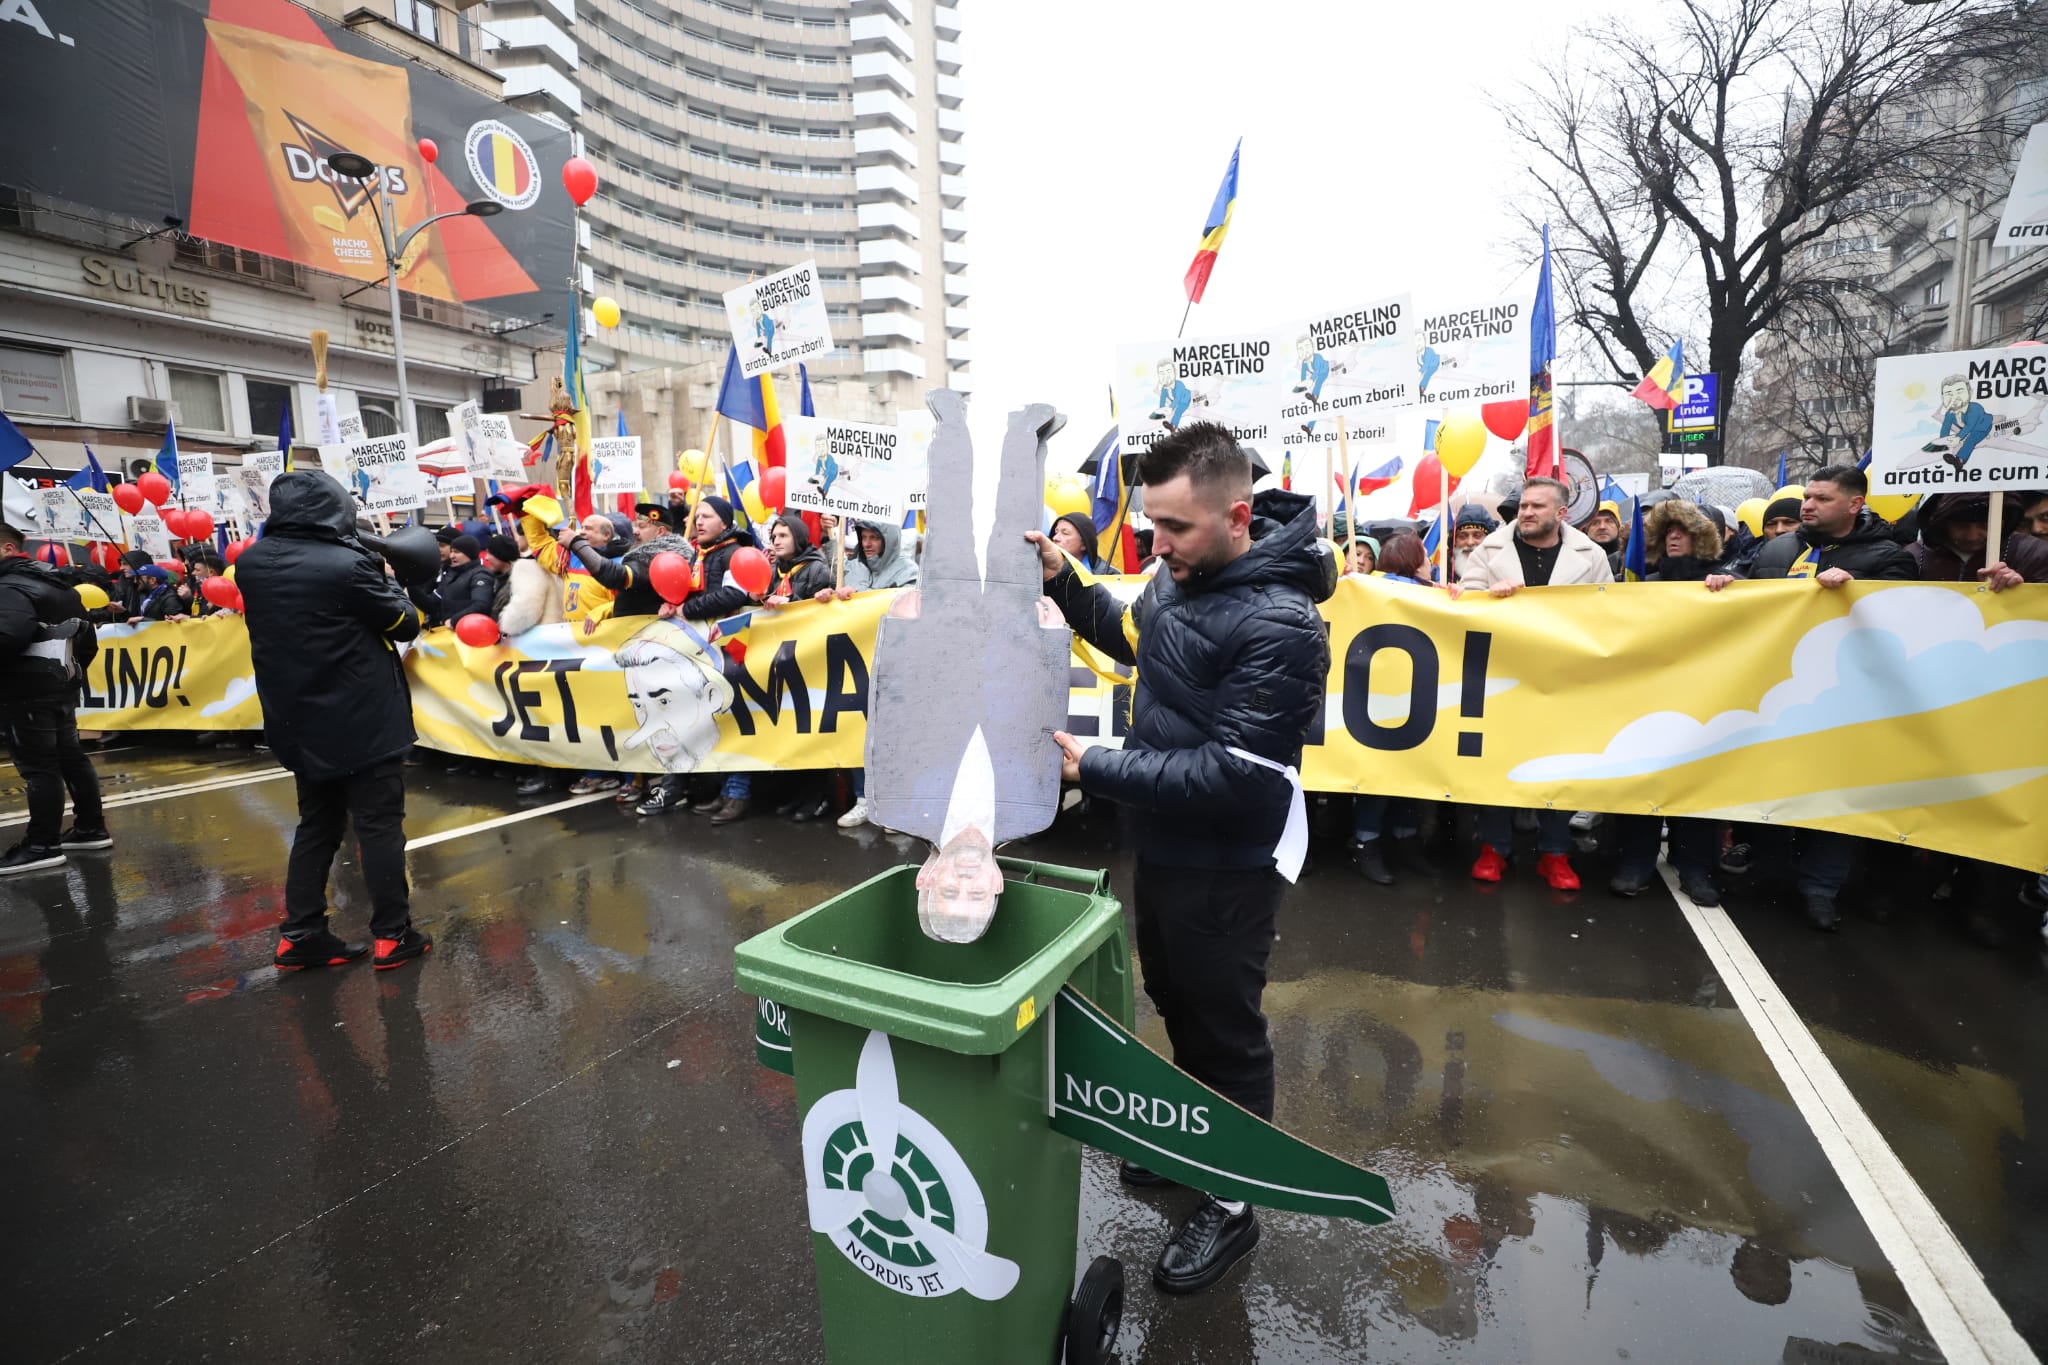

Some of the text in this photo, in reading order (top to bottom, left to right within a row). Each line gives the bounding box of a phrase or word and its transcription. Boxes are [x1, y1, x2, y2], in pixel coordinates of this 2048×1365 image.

[332, 236, 369, 249] NACHO
[334, 247, 374, 259] CHEESE
[755, 269, 811, 301] MARCELINO
[761, 283, 811, 312] BURATINO
[354, 318, 394, 336] HOTE
[1309, 303, 1401, 338] MARCELINO
[1424, 303, 1518, 332] MARCELINO
[1316, 320, 1397, 351] BURATINO
[1429, 319, 1513, 345] BURATINO
[781, 346, 800, 361] cum
[801, 336, 825, 354] zbori!
[1173, 340, 1271, 363] MARCELINO
[1179, 357, 1265, 379] BURATINO
[1332, 394, 1362, 410] cum
[1365, 383, 1405, 403] zbori!
[1440, 389, 1470, 401] cum
[1474, 380, 1515, 398] zbori!
[827, 426, 897, 448] MARCELINO
[1352, 427, 1385, 440] zbori!
[351, 440, 407, 458] MARCELINO
[594, 441, 636, 450] MARCELINO
[596, 448, 634, 458] BURATINO
[830, 439, 893, 461] BURATINO
[178, 456, 208, 467] ARCELINO
[179, 464, 207, 474] URATINO
[357, 451, 406, 468] BURATINO
[1988, 465, 2039, 482] cum
[376, 499, 394, 509] cum
[395, 494, 418, 507] zbori!
[836, 499, 859, 512] cum
[861, 501, 892, 517] zbori!
[79, 644, 192, 709] LINO!
[1064, 1072, 1211, 1136] NORDIS
[845, 1239, 945, 1297] NORDIS JET
